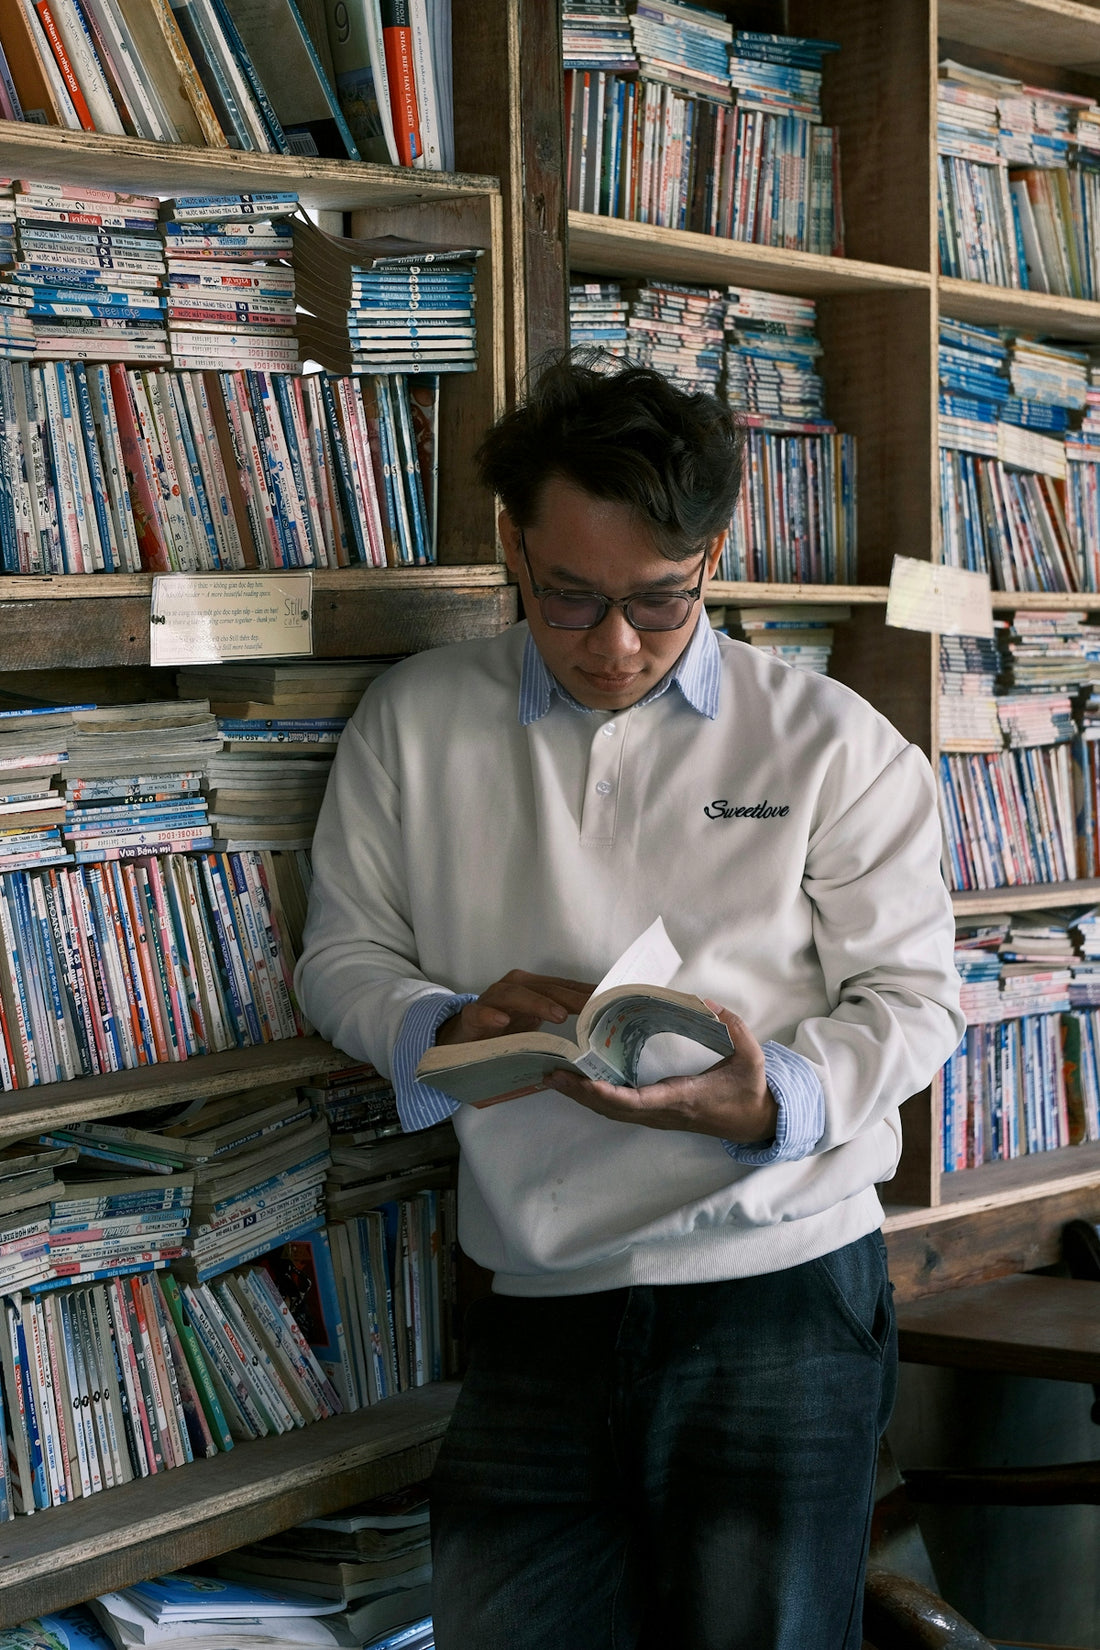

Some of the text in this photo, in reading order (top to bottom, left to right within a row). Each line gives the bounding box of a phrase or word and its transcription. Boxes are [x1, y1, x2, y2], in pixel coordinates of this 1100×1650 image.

[41, 8, 78, 92] Việt Nam tầm nhìn 2050
[79, 386, 93, 426] CLAMP
[322, 390, 341, 428] CLAMP
[277, 461, 284, 470] 3
[284, 598, 303, 616] Still
[704, 800, 790, 820] Sweetlove
[120, 845, 157, 858] Vua Bánh
[43, 884, 52, 899] 1/2
[191, 894, 195, 905] 5
[20, 998, 29, 1020] TRONG
[186, 1336, 199, 1355] SOUL
[200, 1373, 215, 1401] TOURIST
